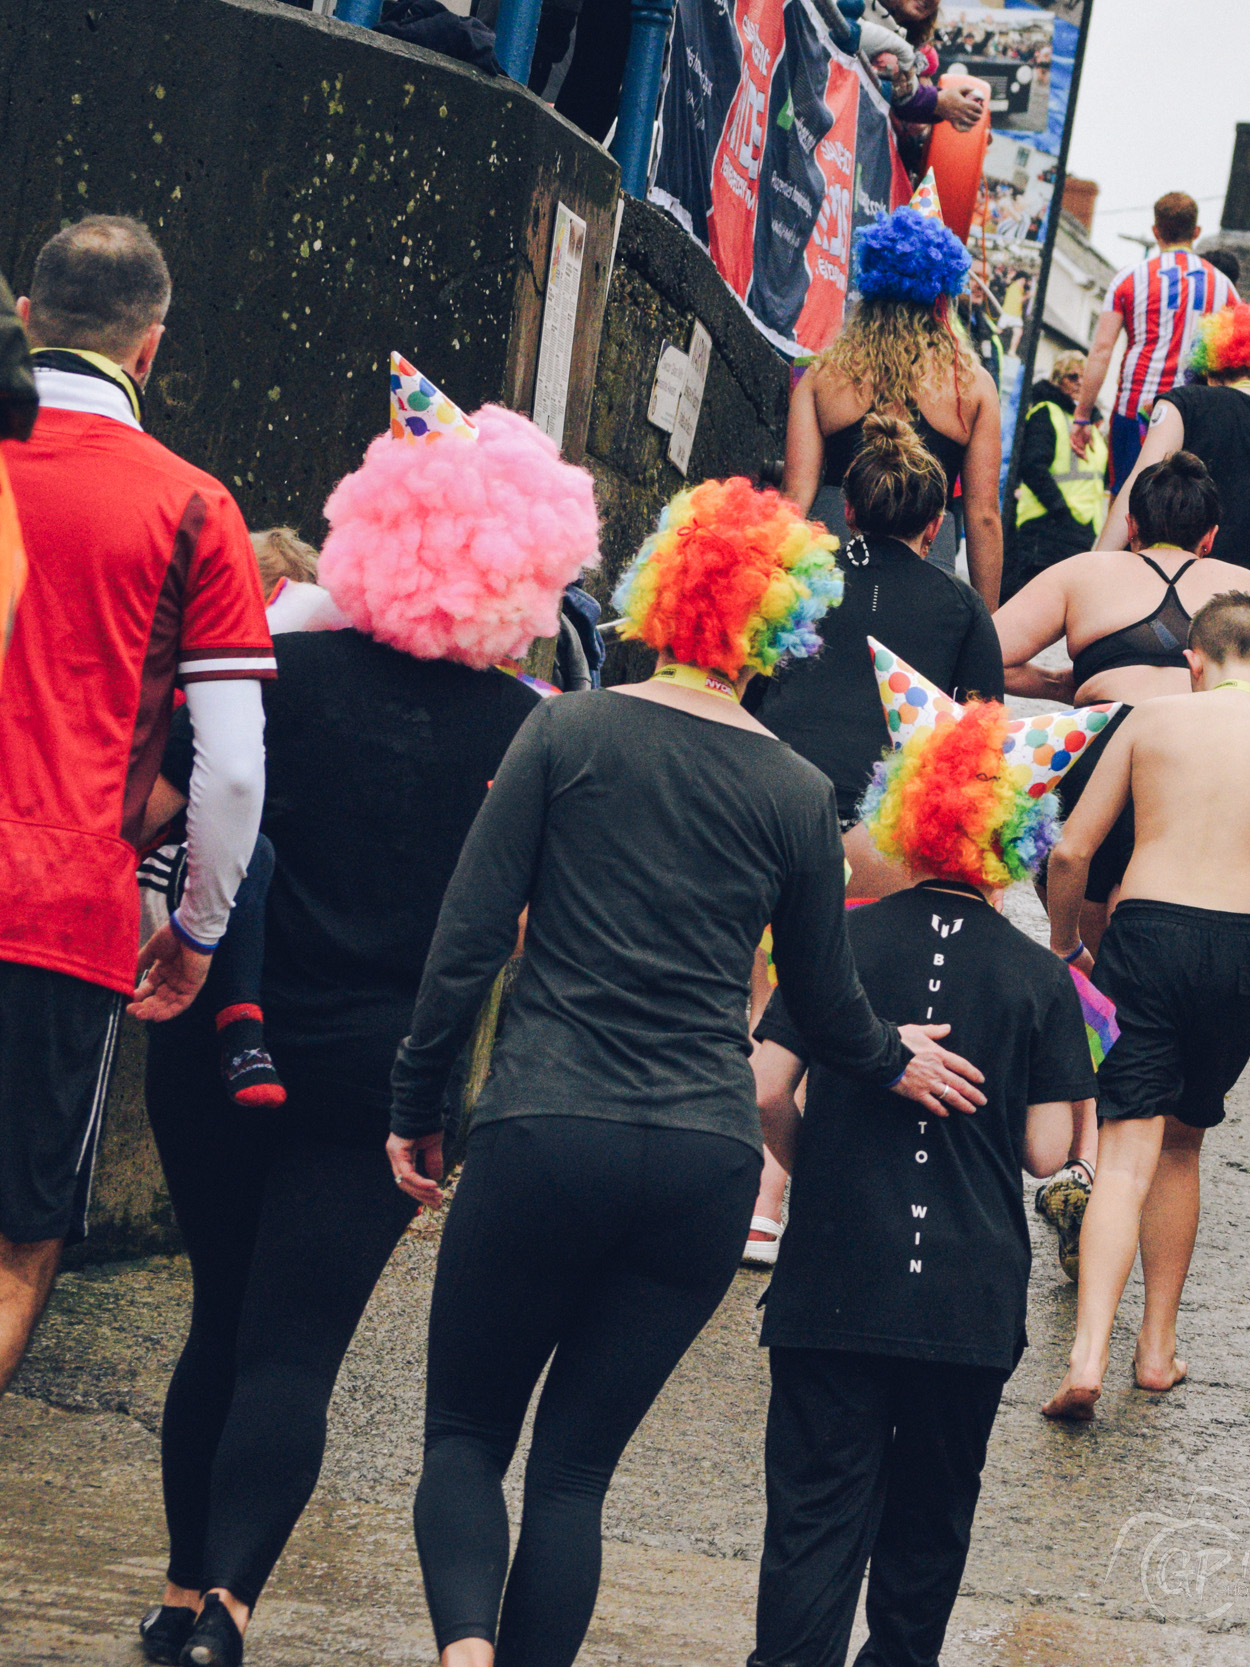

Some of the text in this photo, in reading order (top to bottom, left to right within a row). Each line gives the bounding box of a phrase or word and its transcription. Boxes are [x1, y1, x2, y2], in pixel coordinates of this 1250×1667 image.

[1159, 268, 1205, 311] 11
[915, 1121, 928, 1163] TO
[909, 1204, 928, 1273] WIN
